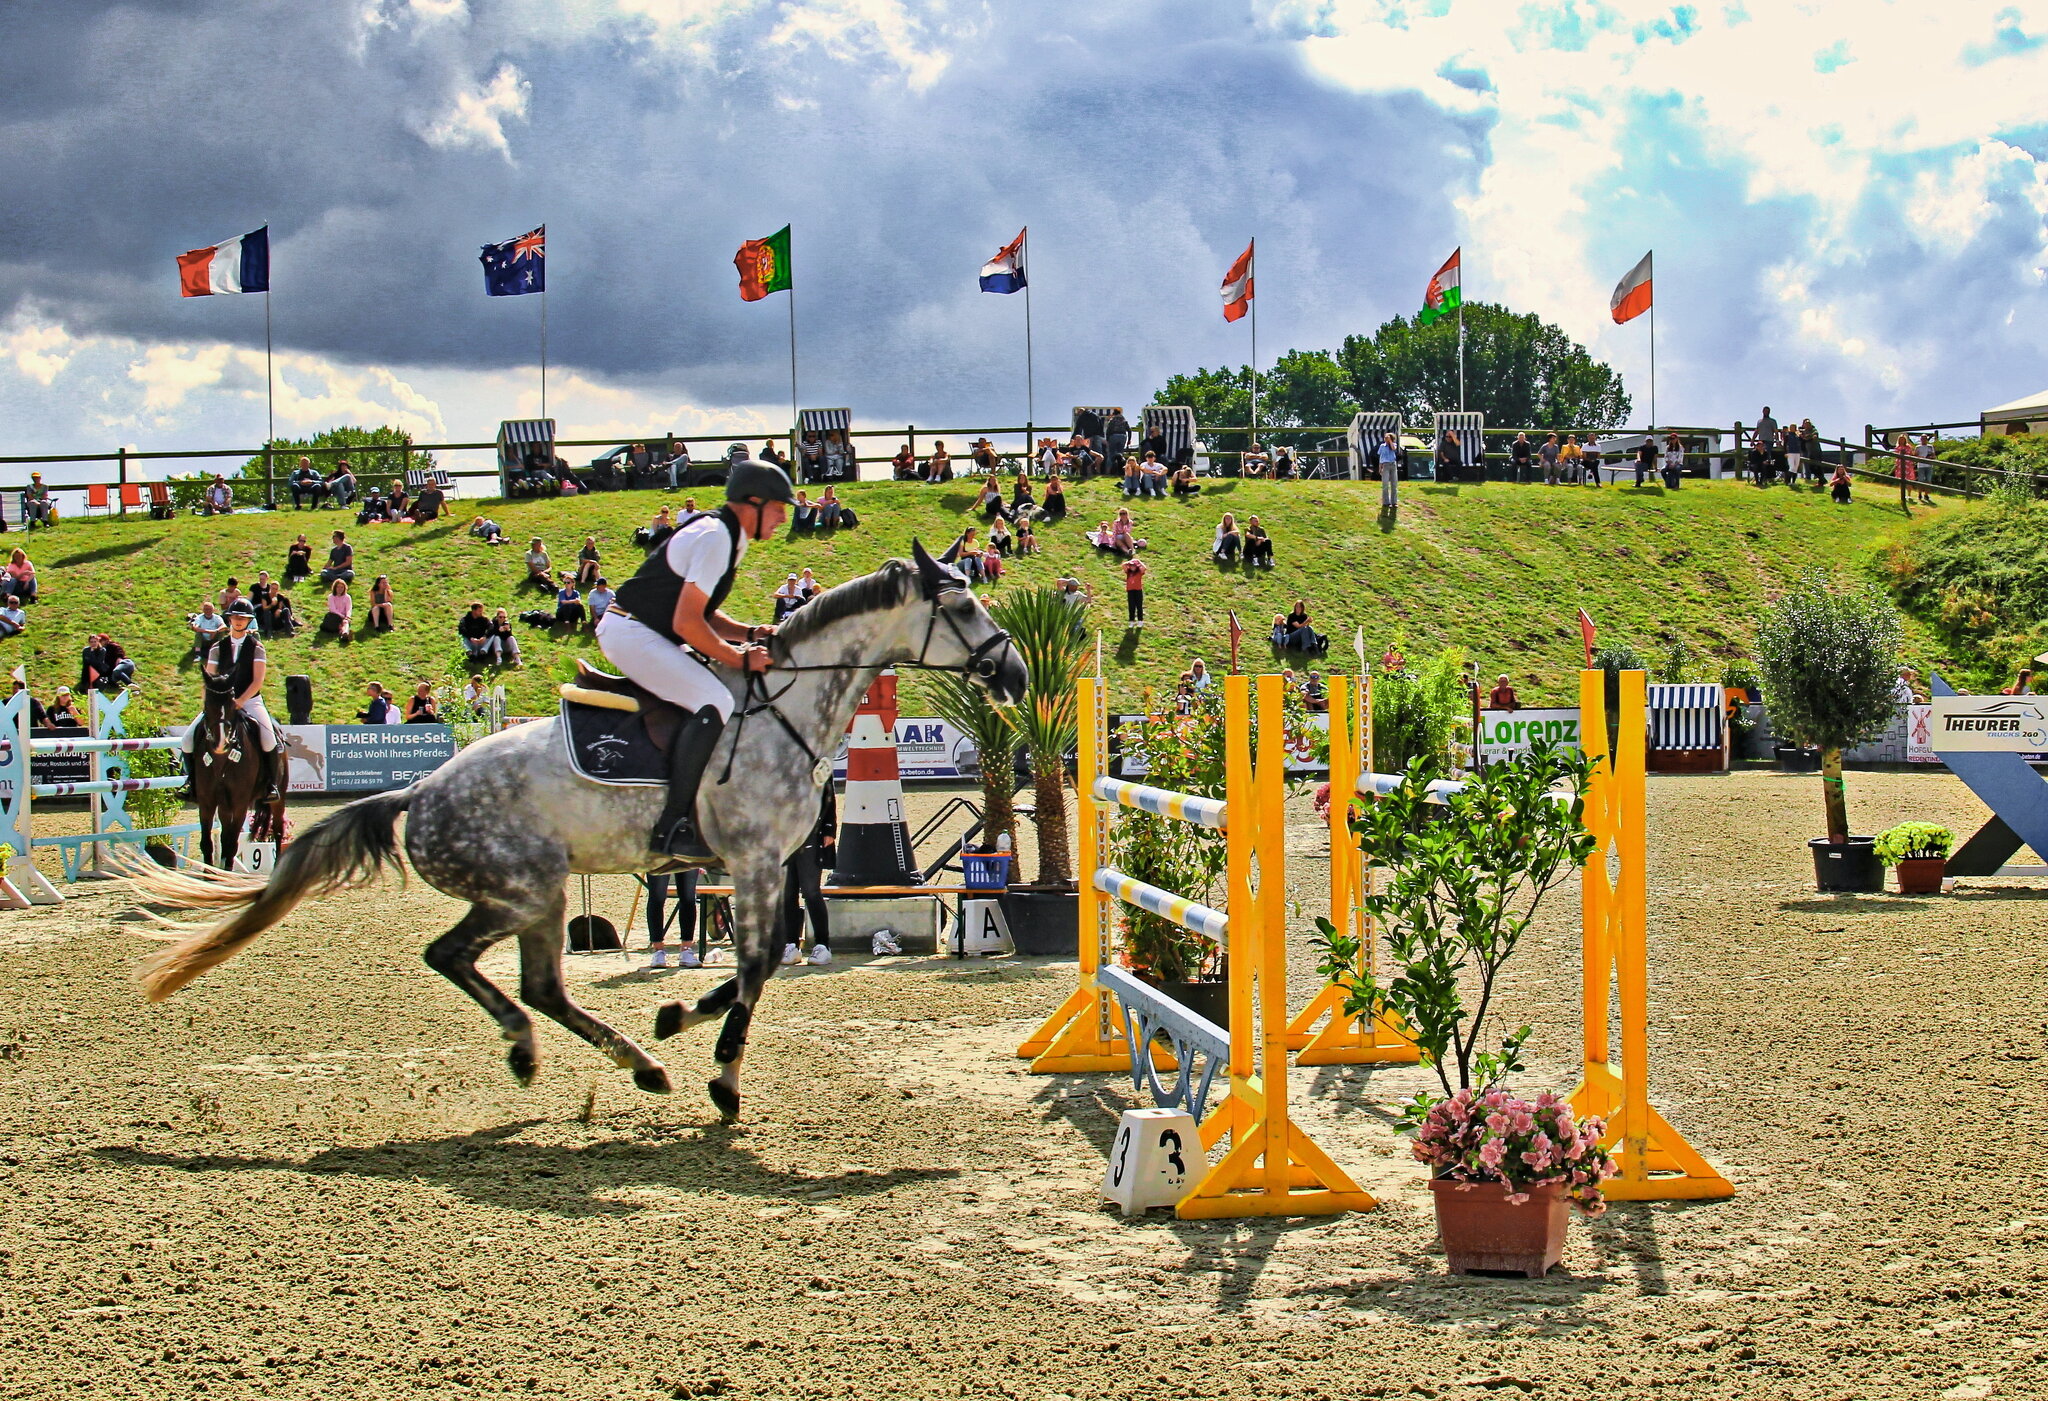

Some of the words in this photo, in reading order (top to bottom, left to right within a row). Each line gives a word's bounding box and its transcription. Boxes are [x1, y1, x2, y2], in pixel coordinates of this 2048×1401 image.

[1480, 716, 1578, 744] Lorenz
[1943, 714, 2021, 731] THEURER
[331, 733, 378, 745] BEMER
[381, 732, 450, 744] Horse-Set.
[331, 750, 345, 759] Für
[348, 750, 363, 759] das
[365, 749, 388, 759] Wohl
[390, 749, 412, 758] Ihres
[413, 748, 450, 758] Pferdes.
[1908, 746, 1933, 754] HOFGU
[392, 770, 436, 784] BEME
[252, 848, 262, 870] 9
[983, 906, 1001, 939] A
[1114, 1126, 1131, 1188] 3
[1159, 1128, 1186, 1187] 3
